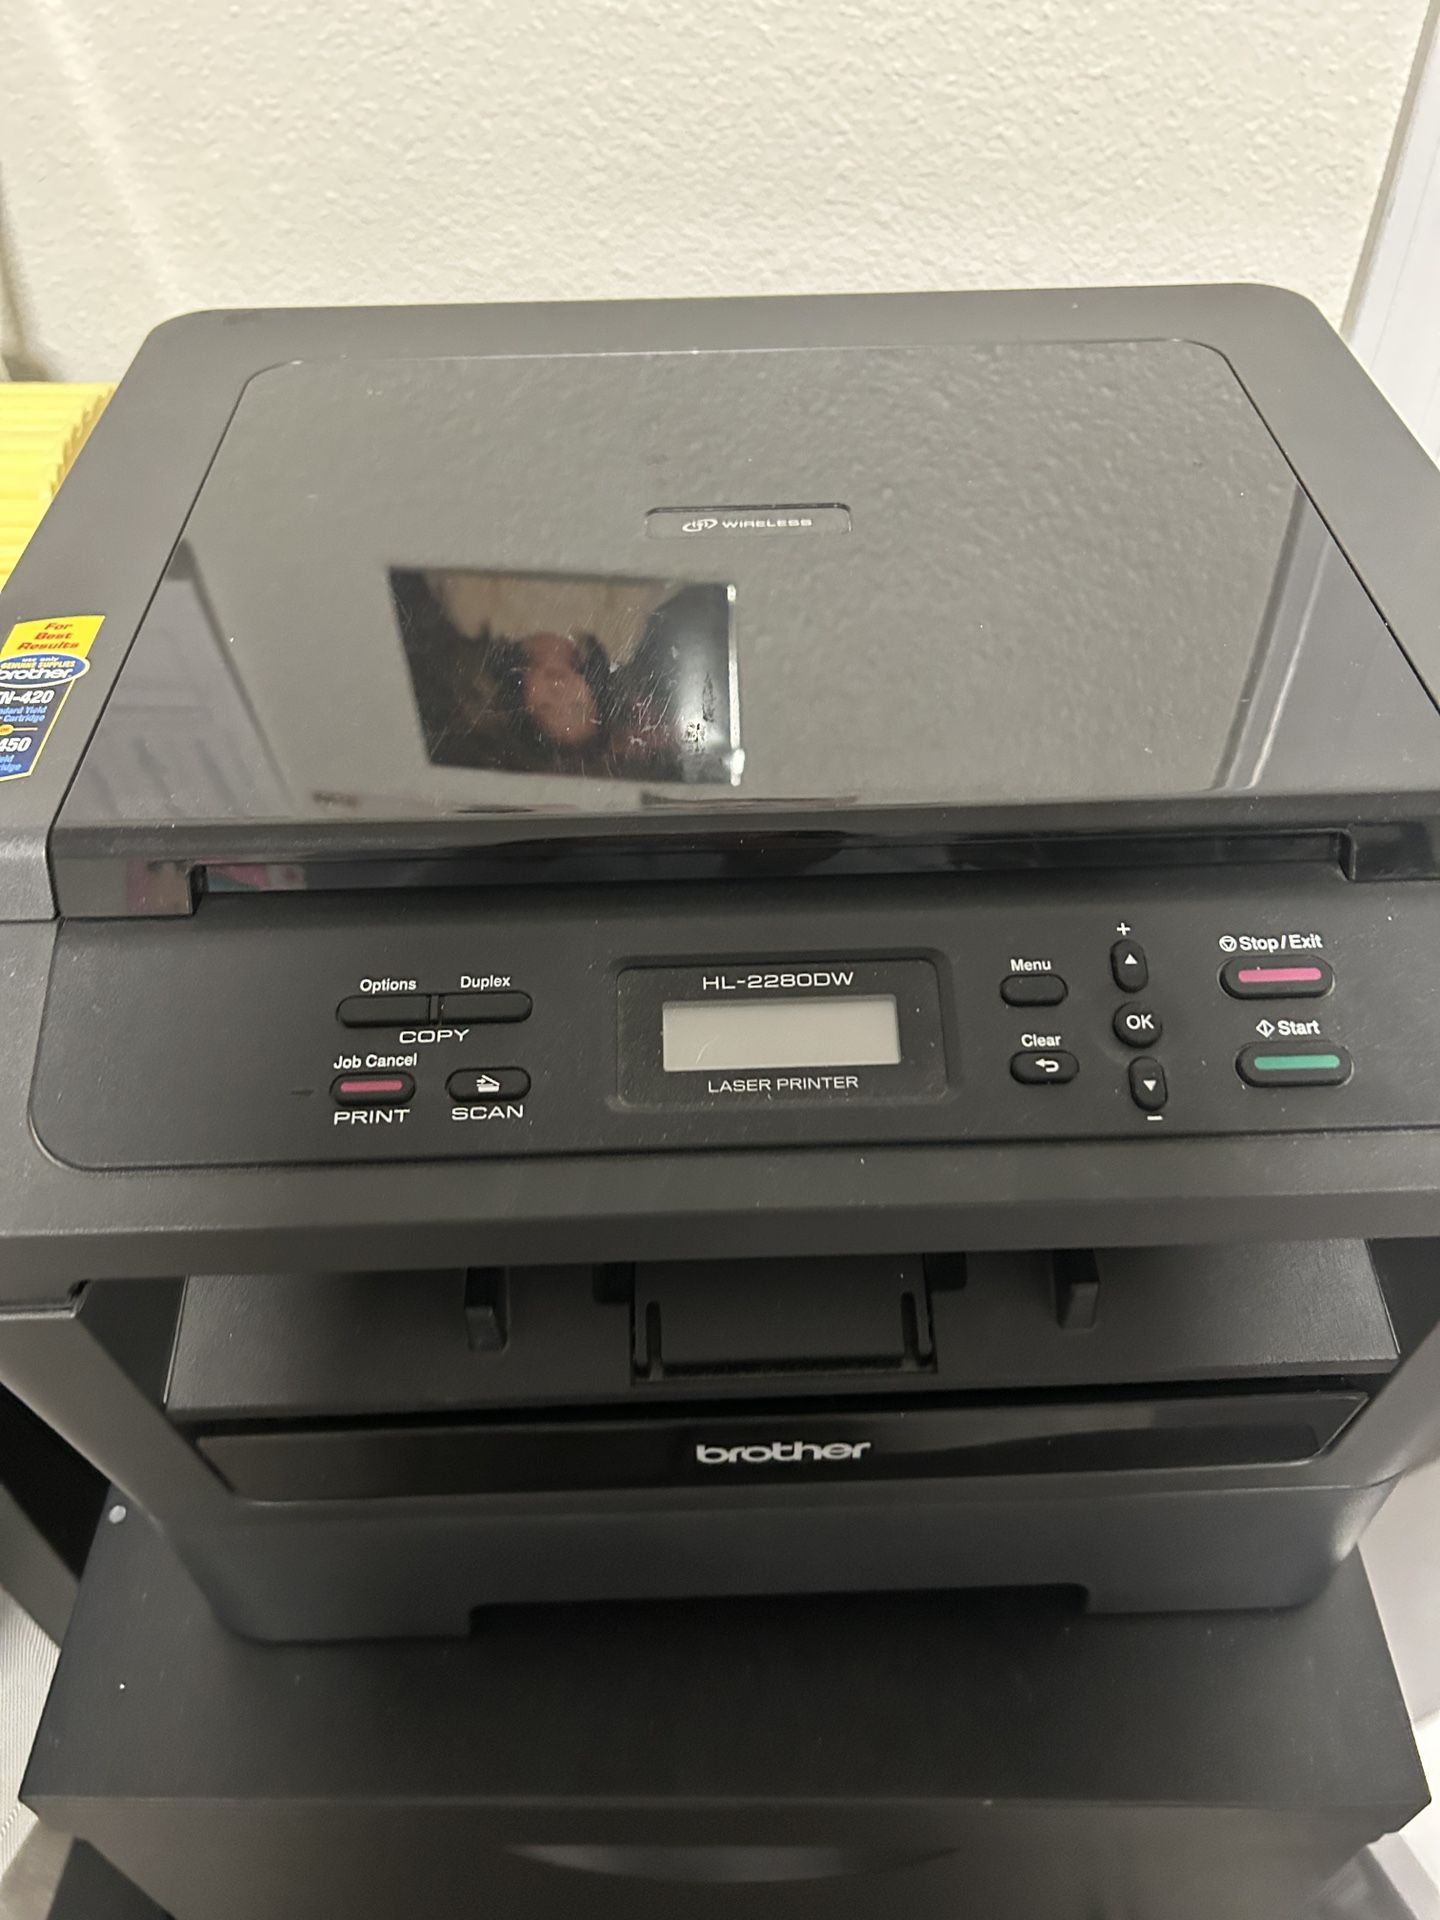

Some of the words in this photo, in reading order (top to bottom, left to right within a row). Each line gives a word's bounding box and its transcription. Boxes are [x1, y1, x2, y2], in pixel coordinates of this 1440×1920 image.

[722, 519, 812, 529] WIRELESS
[44, 622, 74, 631] For
[35, 632, 73, 641] Best
[17, 641, 80, 651] Results
[0, 736, 33, 752] 450
[1010, 958, 1052, 972] Menu
[359, 977, 417, 995] Options
[460, 974, 511, 991] Duplex
[702, 971, 854, 991] HL-2280DW
[1126, 1014, 1155, 1031] OK
[1277, 1020, 1321, 1036] Start
[399, 1028, 470, 1044] COPY
[1021, 1033, 1061, 1048] Clear
[333, 1055, 362, 1070] Job
[365, 1052, 418, 1069] Cancel
[708, 1078, 771, 1094] LASER
[776, 1076, 859, 1092] PRINTER
[333, 1108, 411, 1126] PRINT
[451, 1104, 524, 1121] SCAN
[696, 1441, 871, 1464] brother
